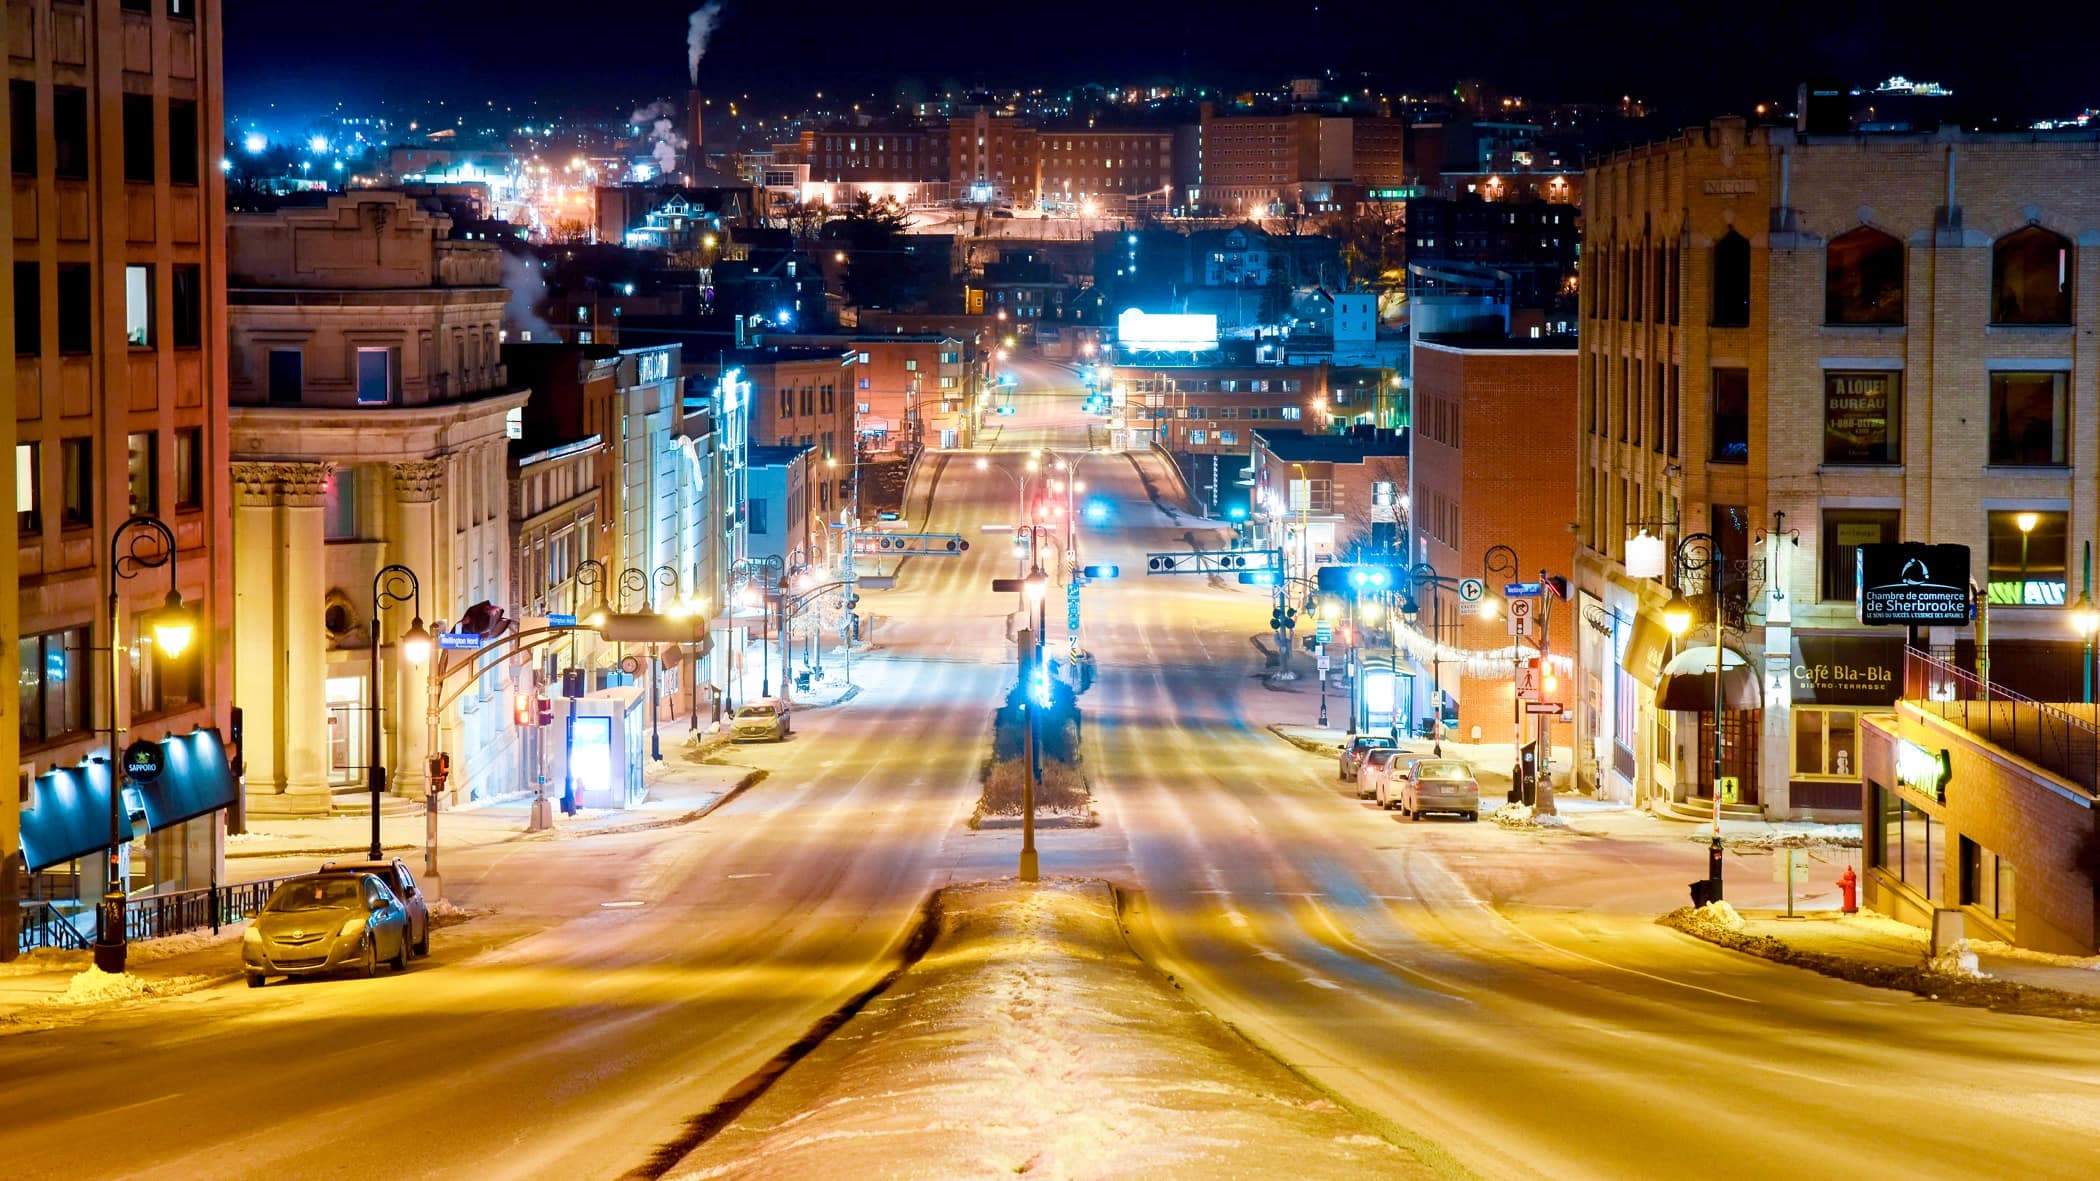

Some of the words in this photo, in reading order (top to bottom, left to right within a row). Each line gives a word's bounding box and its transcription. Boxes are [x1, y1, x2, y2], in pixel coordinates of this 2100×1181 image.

[1829, 398, 1885, 409] BUREAU
[1866, 591, 1904, 600] Chambre
[1906, 591, 1917, 600] de
[1866, 600, 1883, 611] de
[1886, 600, 1965, 612] Sherbrooke
[1794, 664, 1829, 683] Café
[1834, 665, 1892, 681] Bla-Bla
[128, 763, 157, 772] SAPPORO
